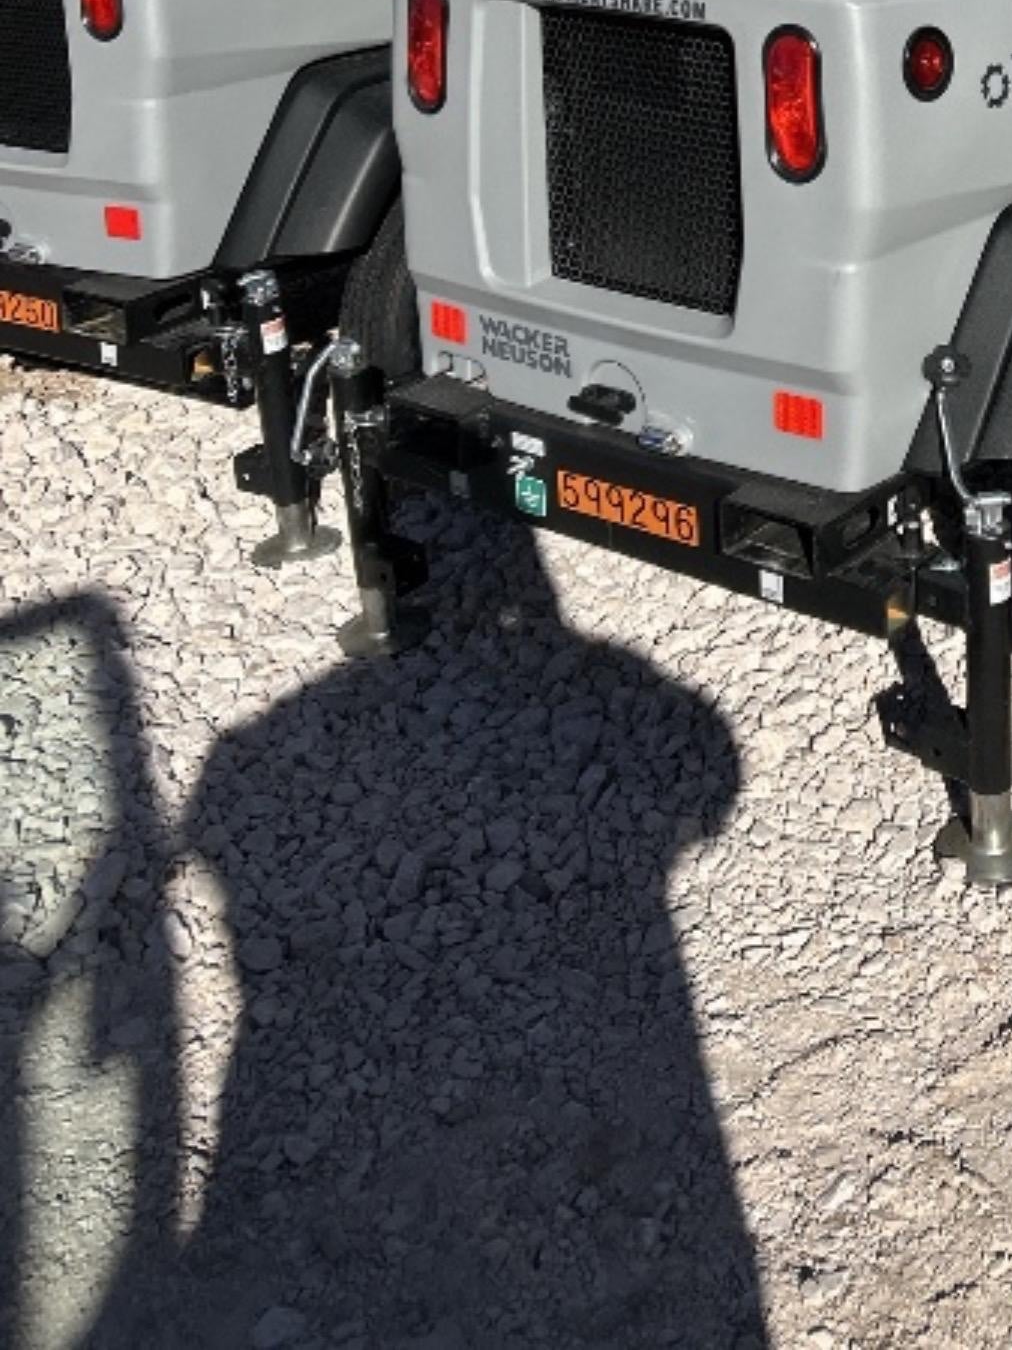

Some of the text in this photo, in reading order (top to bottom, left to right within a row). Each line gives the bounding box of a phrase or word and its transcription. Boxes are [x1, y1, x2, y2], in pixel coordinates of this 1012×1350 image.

[479, 313, 571, 358] WACKER
[482, 335, 573, 379] NEUSON
[562, 473, 694, 540] 599296
